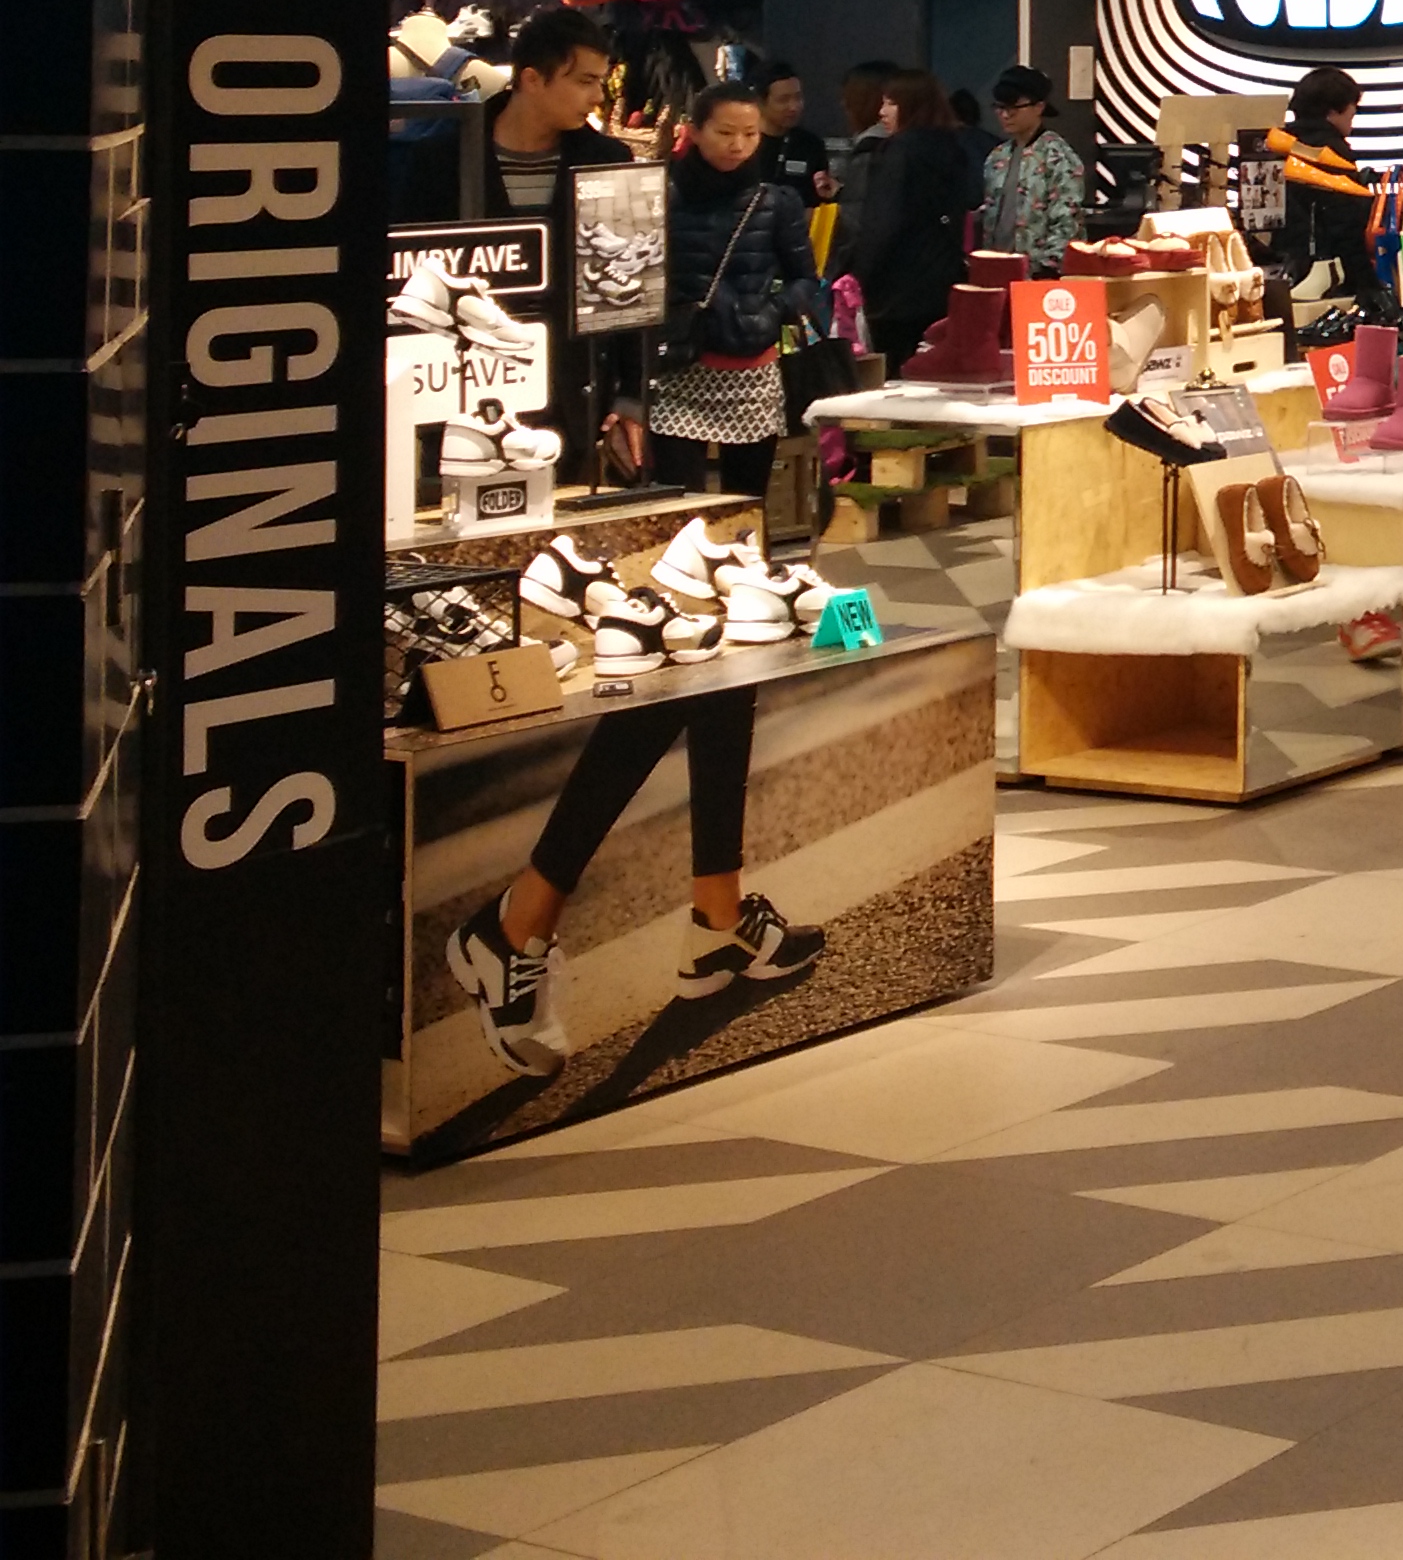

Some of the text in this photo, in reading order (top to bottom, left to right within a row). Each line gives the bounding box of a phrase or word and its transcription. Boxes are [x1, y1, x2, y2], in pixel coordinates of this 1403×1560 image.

[469, 243, 528, 273] AVE.
[1028, 322, 1097, 363] 50%
[1028, 367, 1098, 387] DISCOUNT
[180, 32, 344, 871] ORIGINALS
[482, 490, 523, 512] FOLDER
[836, 600, 873, 634] NEW
